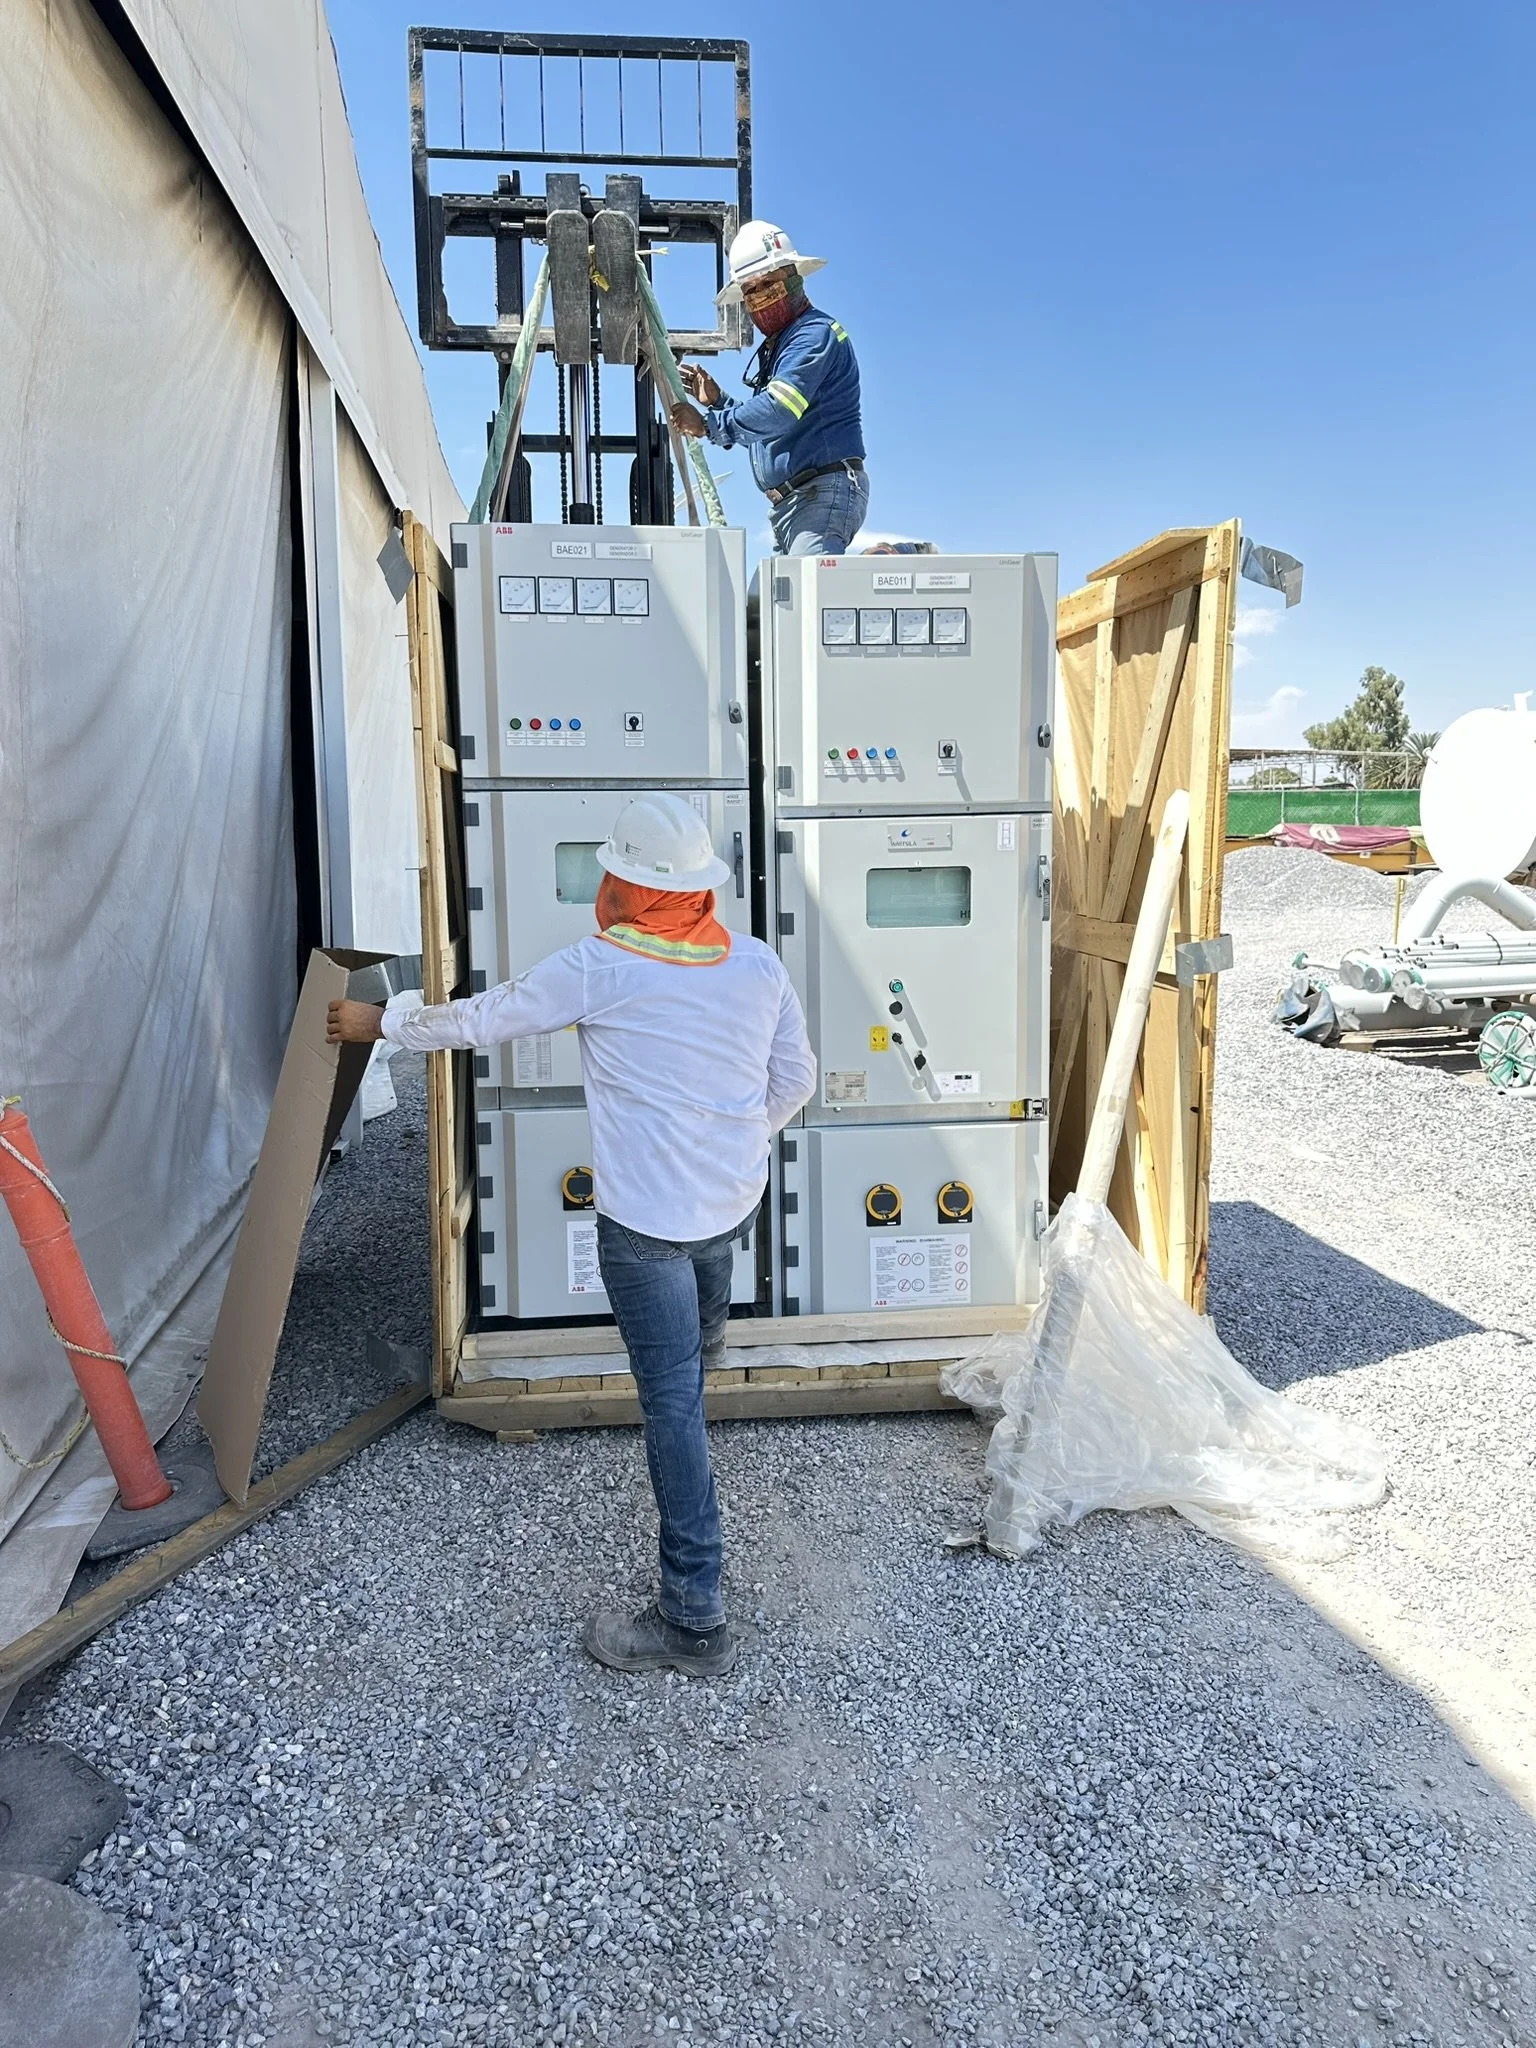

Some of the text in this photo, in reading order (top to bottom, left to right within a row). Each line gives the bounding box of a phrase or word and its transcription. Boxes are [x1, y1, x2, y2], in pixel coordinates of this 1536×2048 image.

[496, 526, 513, 535] ABB
[556, 545, 587, 555] BAE021
[820, 559, 837, 568] ABB
[877, 576, 907, 586] BAE011
